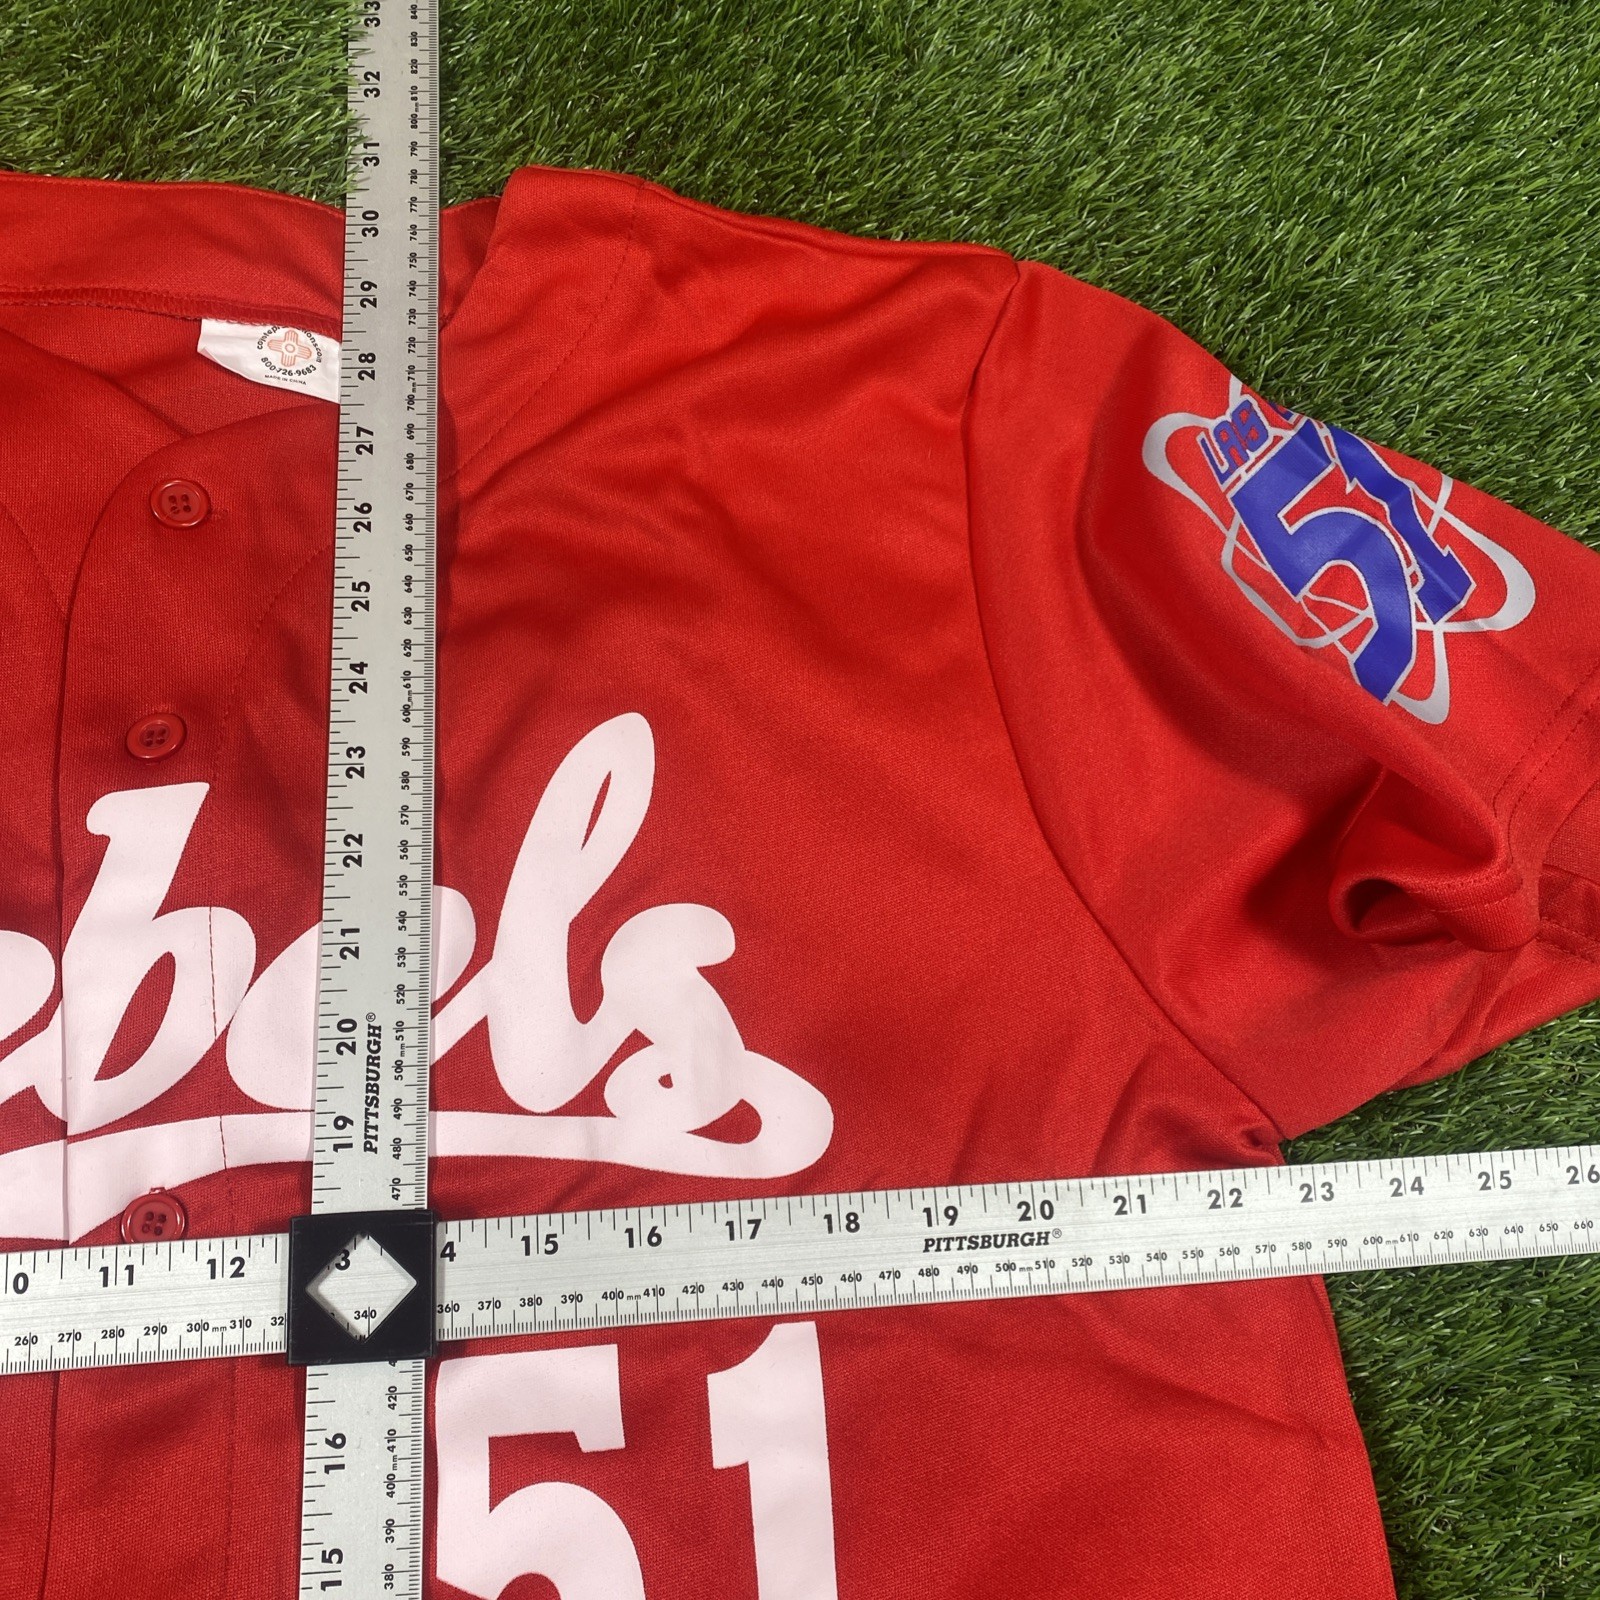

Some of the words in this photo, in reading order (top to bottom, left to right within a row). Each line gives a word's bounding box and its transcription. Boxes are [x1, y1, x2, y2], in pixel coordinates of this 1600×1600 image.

[364, 1, 380, 27] 33
[410, 4, 418, 20] 840
[410, 31, 418, 47] 830
[410, 59, 418, 74] 820
[364, 71, 380, 98] 32
[410, 85, 418, 101] 810
[410, 113, 418, 129] 800
[363, 142, 380, 167] 31
[410, 141, 418, 157] 790
[410, 169, 418, 185] 780
[410, 196, 418, 213] 770
[361, 210, 379, 237] 30
[409, 224, 417, 241] 760
[409, 252, 417, 269] 750
[360, 280, 378, 308] 29
[408, 280, 417, 297] 740
[408, 308, 416, 325] 730
[408, 337, 416, 354] 720
[358, 352, 376, 381] 28
[408, 365, 416, 381] 710
[407, 394, 415, 411] 700
[355, 425, 374, 455] 27
[406, 423, 415, 440] 690
[1197, 394, 1271, 491] LAS
[406, 453, 414, 470] 680
[405, 482, 414, 501] 670
[353, 502, 373, 533] 26
[405, 513, 414, 531] 660
[404, 544, 413, 562] 650
[404, 575, 413, 593] 640
[351, 581, 371, 612] 25
[404, 607, 412, 625] 630
[403, 639, 412, 657] 620
[348, 661, 368, 694] 24
[403, 670, 412, 689] 610
[402, 704, 411, 723] 600
[402, 737, 411, 757] 590
[345, 746, 366, 779] 23
[401, 771, 410, 790] 580
[400, 805, 409, 825] 570
[342, 834, 363, 868] 22
[400, 839, 409, 860] 560
[399, 875, 408, 896] 550
[398, 910, 407, 931] 540
[339, 928, 360, 960] 21
[397, 947, 407, 968] 530
[396, 984, 406, 1005] 520
[335, 1018, 358, 1056] 20
[395, 1020, 405, 1041] 510
[400, 1043, 405, 1057] mm
[394, 1059, 404, 1081] 500
[393, 1098, 403, 1120] 490
[332, 1115, 354, 1153] 19
[392, 1137, 402, 1160] 480
[391, 1177, 401, 1200] 470
[13, 1273, 29, 1294] 0
[99, 1264, 135, 1288] 11
[206, 1256, 246, 1280] 12
[334, 1249, 351, 1271] 3
[440, 1241, 457, 1262] 4
[521, 1233, 559, 1257] 15
[625, 1225, 663, 1249] 16
[725, 1218, 762, 1241] 17
[823, 1211, 861, 1235] 18
[922, 1205, 959, 1228] 19
[1016, 1199, 1055, 1222] 20
[1113, 1194, 1147, 1216] 21
[1207, 1187, 1243, 1210] 22
[1300, 1181, 1334, 1203] 23
[1389, 1176, 1425, 1197] 24
[1477, 1170, 1512, 1192] 25
[1566, 1164, 1600, 1185] 26
[14, 1334, 38, 1347] 260
[57, 1331, 82, 1343] 270
[101, 1327, 125, 1340] 280
[143, 1324, 168, 1336] 290
[186, 1321, 210, 1333] 300
[211, 1325, 228, 1333] mm
[229, 1318, 252, 1330] 310
[270, 1315, 285, 1327] 32
[353, 1308, 377, 1320] 340
[437, 1303, 460, 1314] 360
[477, 1299, 502, 1311] 370
[519, 1296, 543, 1308] 380
[560, 1293, 584, 1304] 390
[601, 1290, 625, 1301] 400
[626, 1293, 642, 1301] mm
[643, 1287, 666, 1298] 410
[681, 1284, 705, 1295] 420
[722, 1281, 745, 1292] 430
[761, 1277, 784, 1289] 440
[800, 1275, 824, 1286] 450
[840, 1272, 863, 1283] 460
[878, 1269, 901, 1280] 470
[917, 1266, 940, 1278] 480
[956, 1264, 979, 1275] 490
[995, 1261, 1017, 1273] 500
[1018, 1265, 1034, 1273] mm
[1035, 1259, 1056, 1270] 510
[1071, 1256, 1093, 1268] 520
[1109, 1254, 1131, 1265] 530
[1146, 1251, 1168, 1262] 540
[1182, 1249, 1204, 1260] 550
[1219, 1246, 1241, 1257] 560
[1255, 1243, 1277, 1254] 570
[1291, 1241, 1312, 1252] 580
[1327, 1238, 1348, 1248] 590
[1362, 1235, 1384, 1246] 600
[1400, 1233, 1420, 1243] 610
[1433, 1230, 1454, 1240] 620
[1468, 1228, 1489, 1238] 630
[1504, 1225, 1524, 1235] 640
[1539, 1223, 1559, 1233] 650
[1573, 1220, 1594, 1230] 660
[387, 1386, 398, 1411] 420
[386, 1428, 397, 1453] 410
[324, 1432, 347, 1475] 16
[392, 1454, 398, 1471] mm
[386, 1473, 396, 1498] 400
[385, 1518, 395, 1544] 390
[320, 1548, 344, 1592] 15
[384, 1564, 394, 1590] 380
